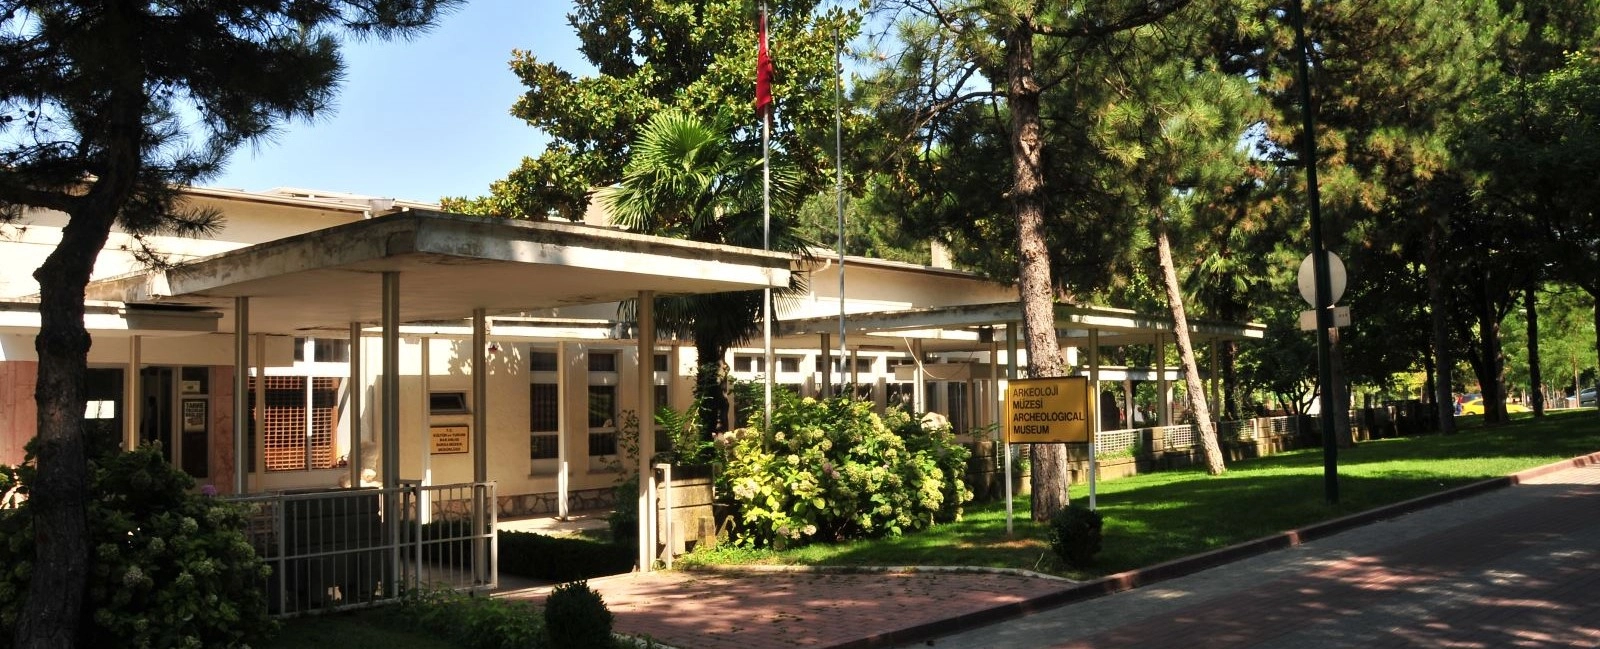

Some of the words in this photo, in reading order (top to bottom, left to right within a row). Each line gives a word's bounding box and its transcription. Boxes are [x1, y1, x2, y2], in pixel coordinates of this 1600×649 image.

[1013, 398, 1043, 410] MÜZESİ
[1013, 411, 1085, 422] ARCHEOLOGICAL
[1013, 425, 1050, 435] MUSEUM
